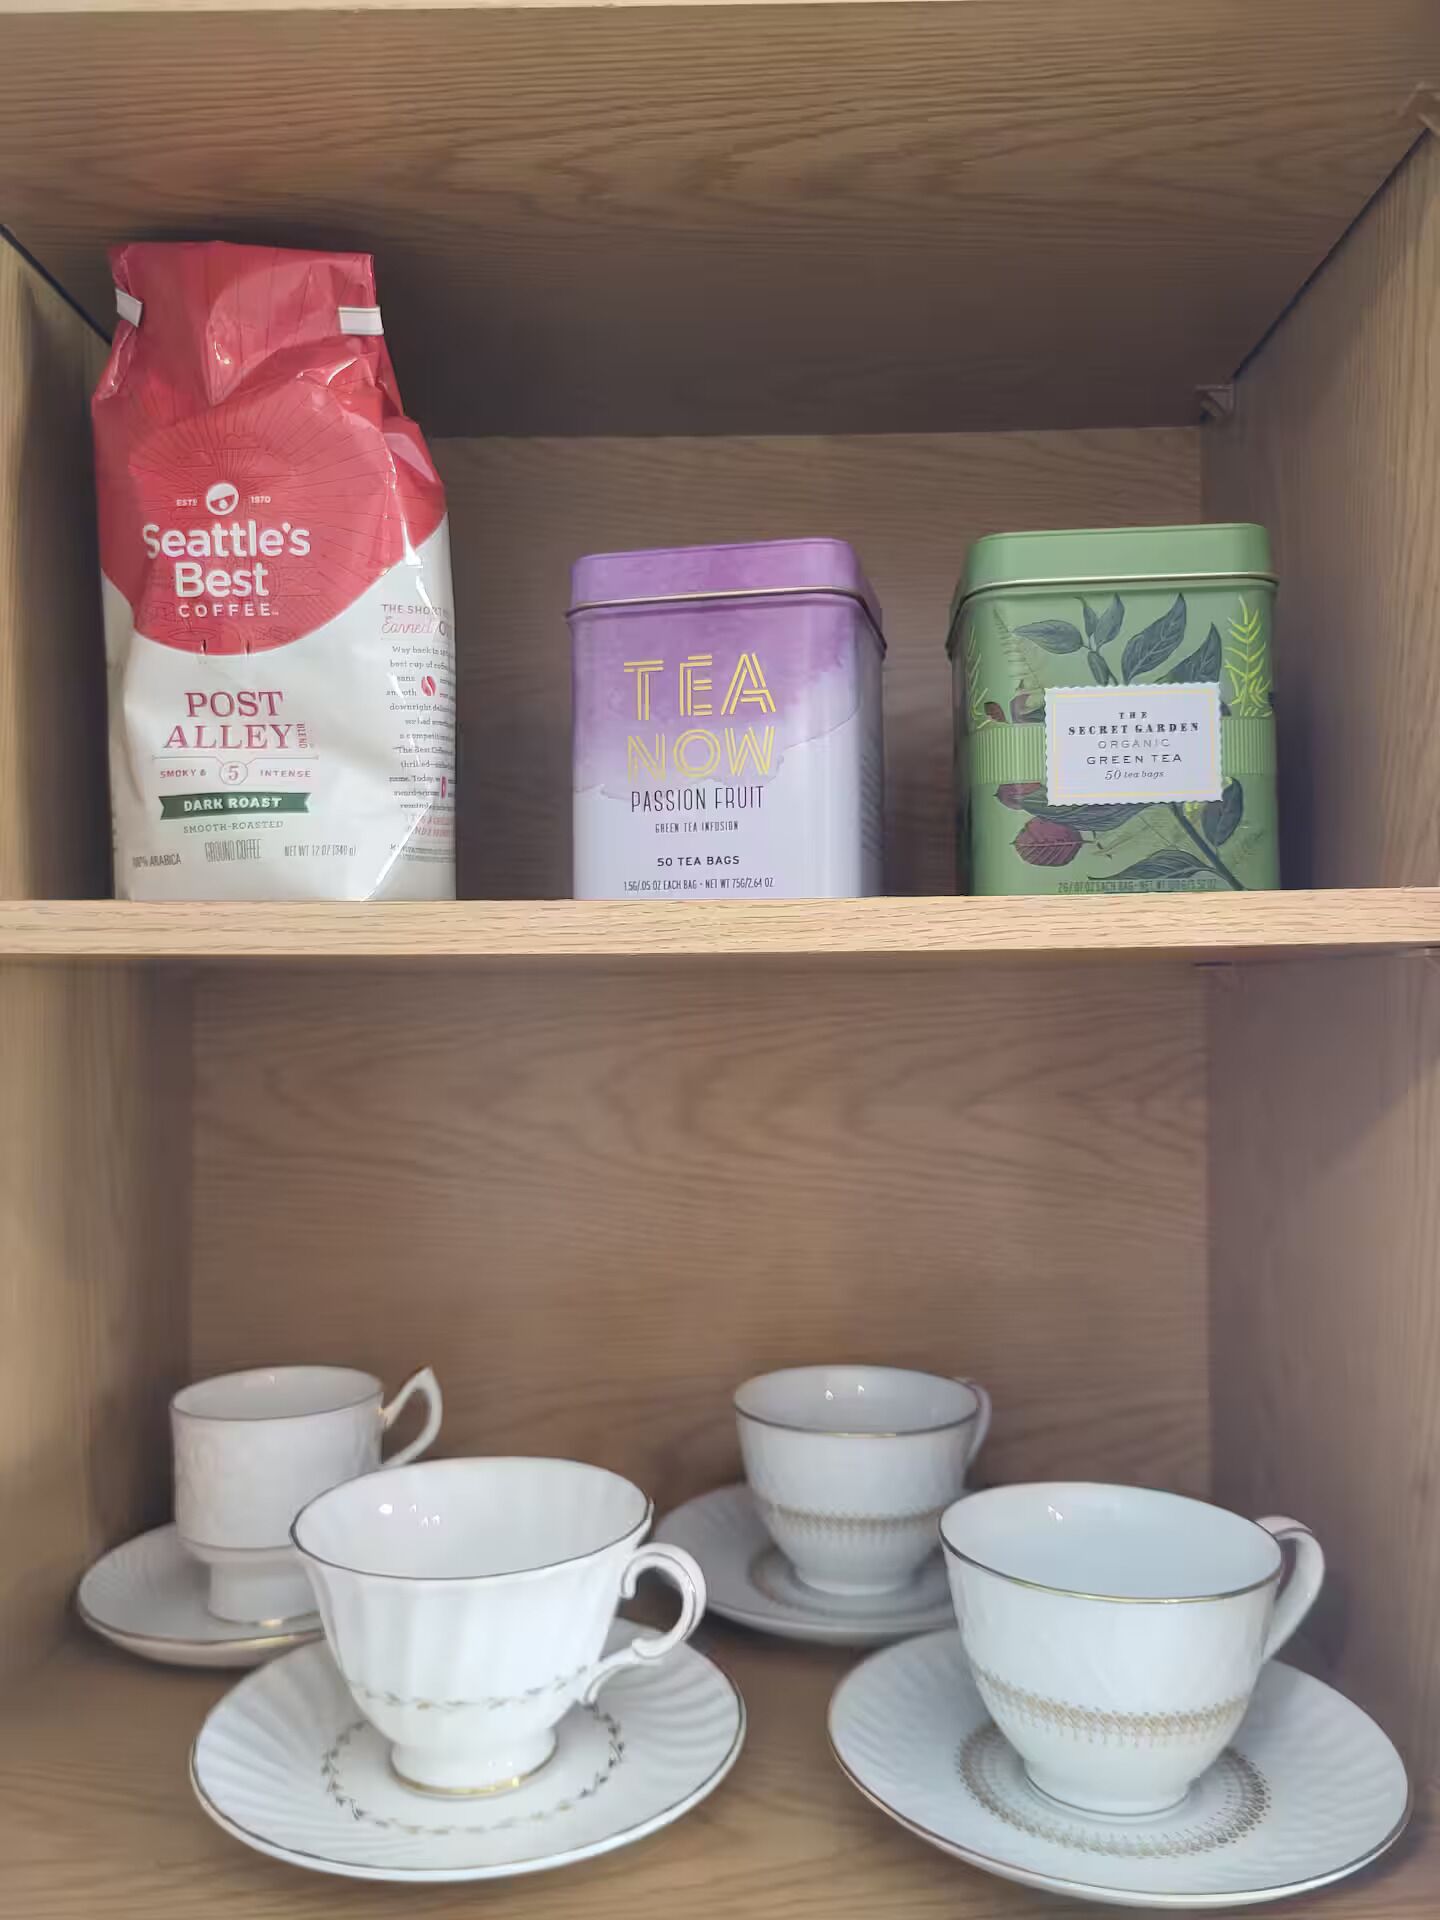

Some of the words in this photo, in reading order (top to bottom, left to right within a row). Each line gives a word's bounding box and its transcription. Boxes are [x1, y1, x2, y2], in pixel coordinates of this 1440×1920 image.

[250, 495, 272, 504] 1970
[143, 520, 311, 560] Seattle's
[174, 562, 270, 599] Best
[178, 603, 272, 618] COFFEE
[381, 604, 404, 616] THE
[624, 652, 776, 720] TEA
[184, 690, 284, 718] POST
[1118, 711, 1149, 720] THE
[1068, 724, 1128, 736] SECRET
[1135, 722, 1200, 735] GARDEN
[163, 723, 295, 750] ALLEY
[1097, 738, 1171, 749] ORGANIC
[627, 725, 775, 785] NOW
[1086, 755, 1144, 766] GREEN
[1151, 753, 1182, 764] TEA
[160, 768, 197, 779] SMOKY
[228, 764, 240, 782] 5
[260, 769, 312, 779] INTENSE
[1104, 769, 1121, 781] 50
[1124, 770, 1140, 779] tea
[1141, 770, 1165, 780] bags
[183, 798, 224, 812] DARK
[228, 796, 282, 809] ROAST
[631, 787, 707, 813] PASSION
[714, 785, 764, 811] FRUIT
[183, 820, 284, 835] SMOOTH-ROASTED
[655, 822, 679, 834] GREEN
[684, 821, 698, 833] TEA
[701, 820, 739, 832] INFUSION
[204, 840, 235, 863] GROUND
[236, 838, 262, 860] COFFEE
[284, 844, 297, 857] NET
[299, 844, 309, 857] WT
[149, 853, 182, 867] ARABICA
[657, 857, 673, 867] 50
[677, 856, 702, 867] TEA
[706, 855, 740, 866] BAGS
[653, 880, 662, 891] OZ
[663, 880, 681, 890] EACH
[683, 879, 697, 890] BAG
[705, 879, 718, 889] NET
[720, 878, 730, 889] WT
[765, 877, 774, 888] OZ
